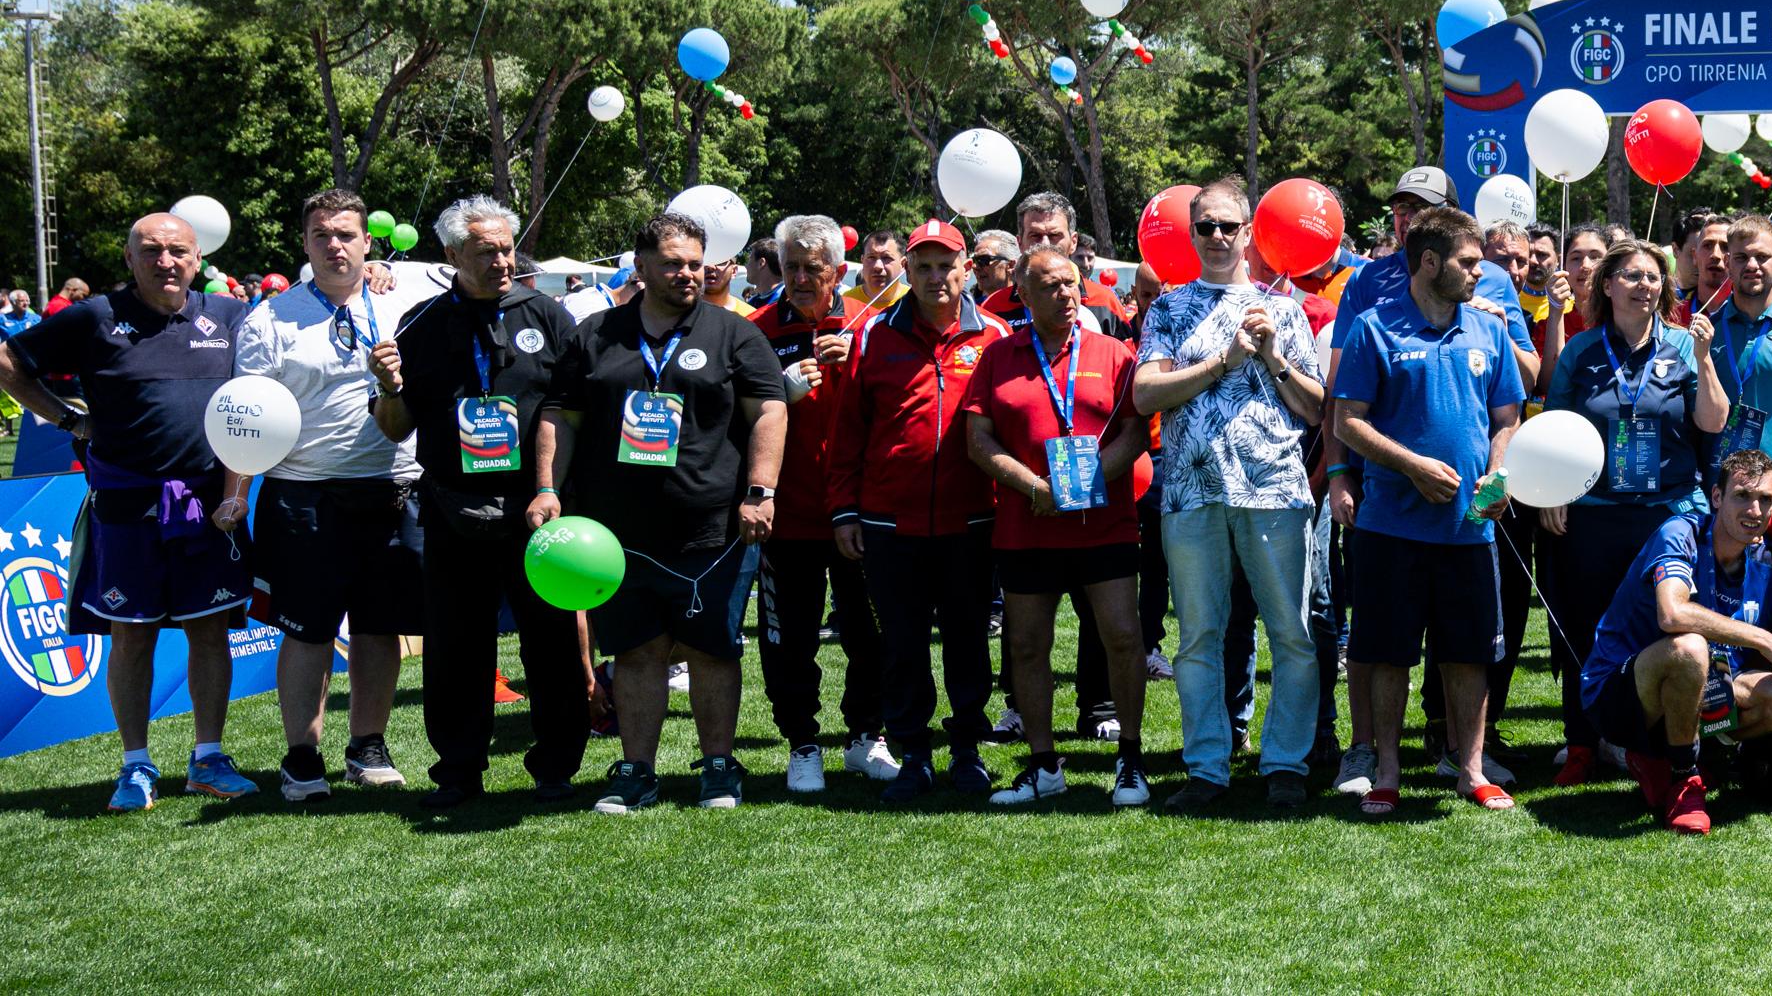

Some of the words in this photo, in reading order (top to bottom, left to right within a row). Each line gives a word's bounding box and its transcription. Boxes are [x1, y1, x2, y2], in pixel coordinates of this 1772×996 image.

[1645, 11, 1757, 46] FINALE
[1584, 48, 1611, 61] FIGC
[1645, 65, 1682, 82] CPO
[1689, 63, 1768, 82] TIRRENIA
[1629, 129, 1649, 146] TUTTI
[1477, 152, 1497, 162] FIGC
[1511, 209, 1528, 220] TUTTI
[1377, 296, 1398, 305] Ze
[190, 339, 229, 349] Mediacom
[218, 395, 232, 404] #IL
[217, 404, 263, 417] CALCIO
[227, 427, 261, 438] TUTTI
[630, 452, 667, 462] SQUADRA
[473, 459, 511, 469] SQUADRA
[42, 637, 64, 649] ITALIA
[230, 640, 276, 658] RIMENTALE
[1704, 719, 1731, 733] SQUADRA
